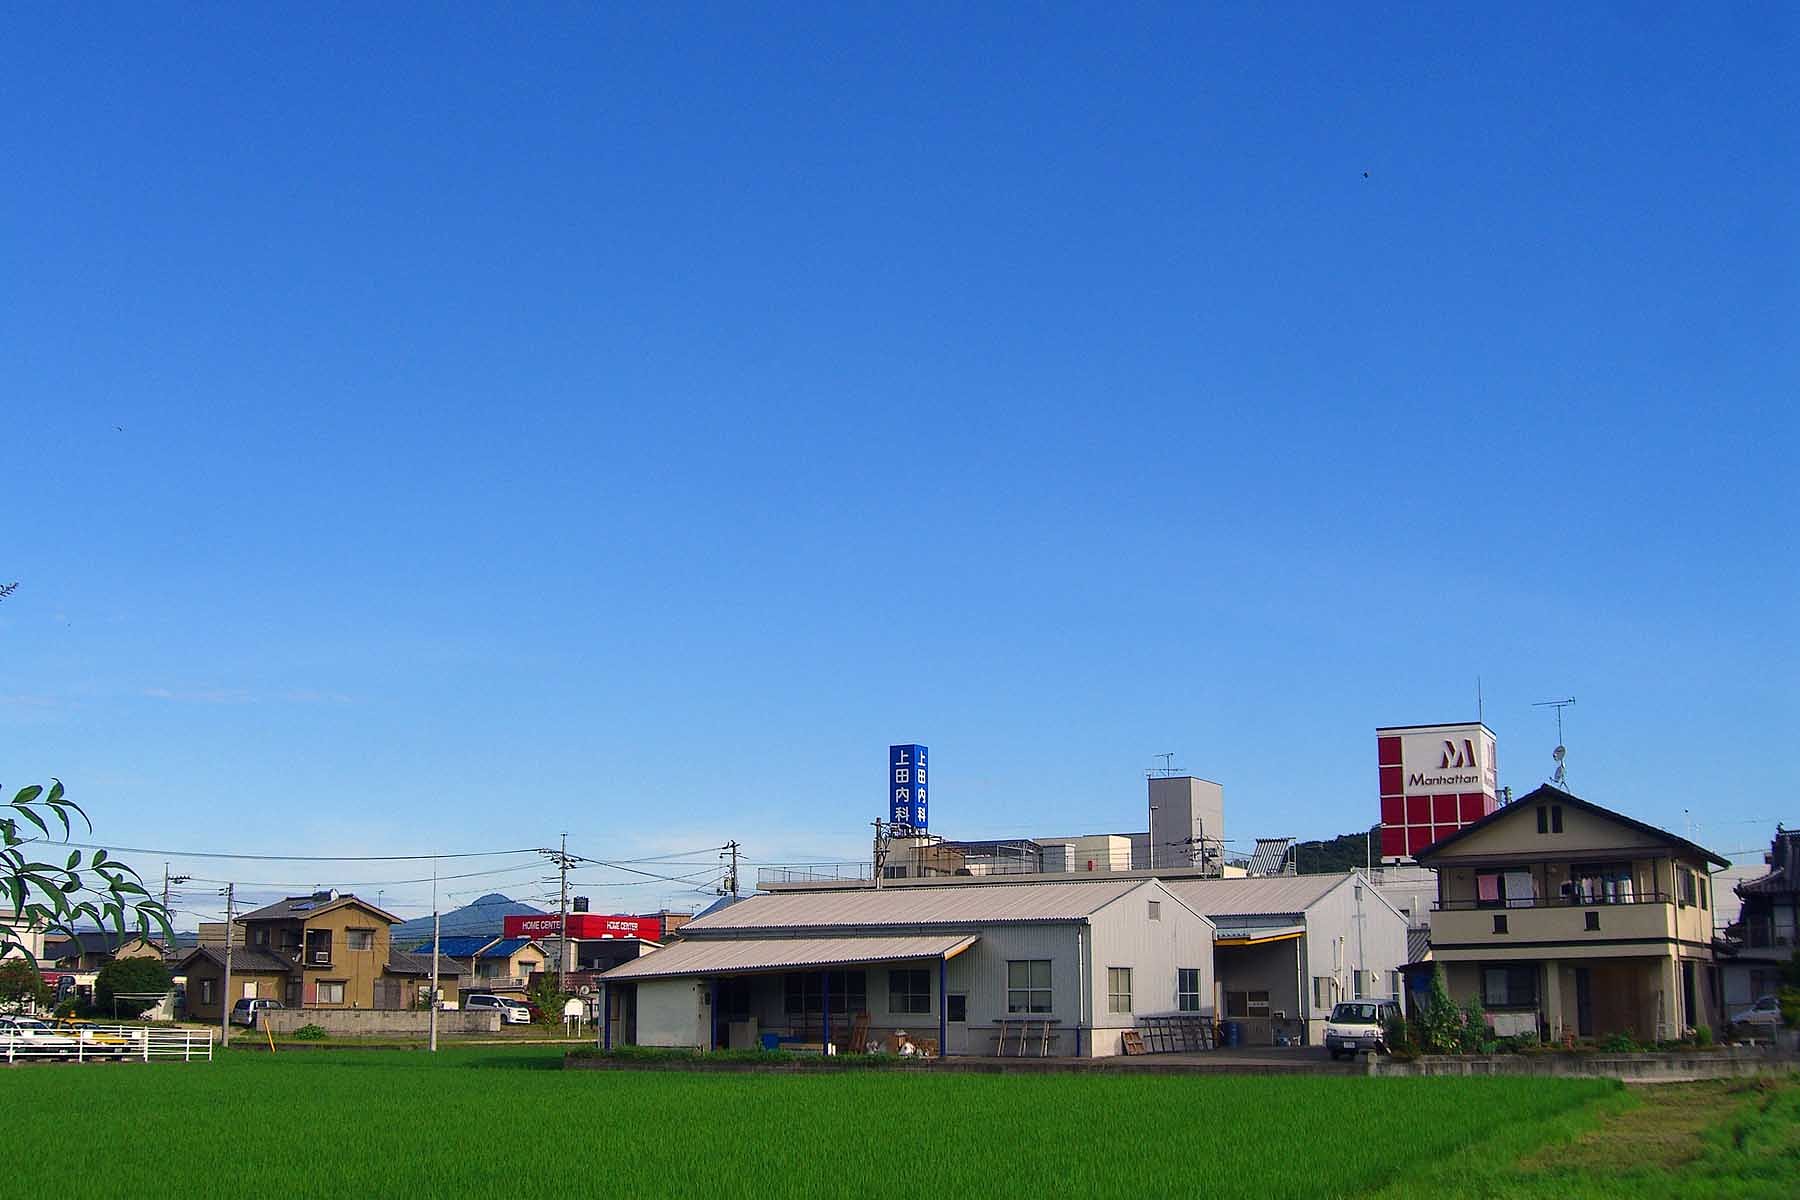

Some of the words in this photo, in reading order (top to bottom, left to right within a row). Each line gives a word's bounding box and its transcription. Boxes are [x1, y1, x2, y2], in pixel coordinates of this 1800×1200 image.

[895, 750, 910, 822] 上田内科
[917, 750, 926, 822] 上田内科
[1409, 773, 1479, 787] Manhattan
[522, 920, 540, 930] HOME
[541, 920, 561, 930] CENTE
[607, 920, 620, 930] HOME
[621, 921, 638, 931] CENTER
